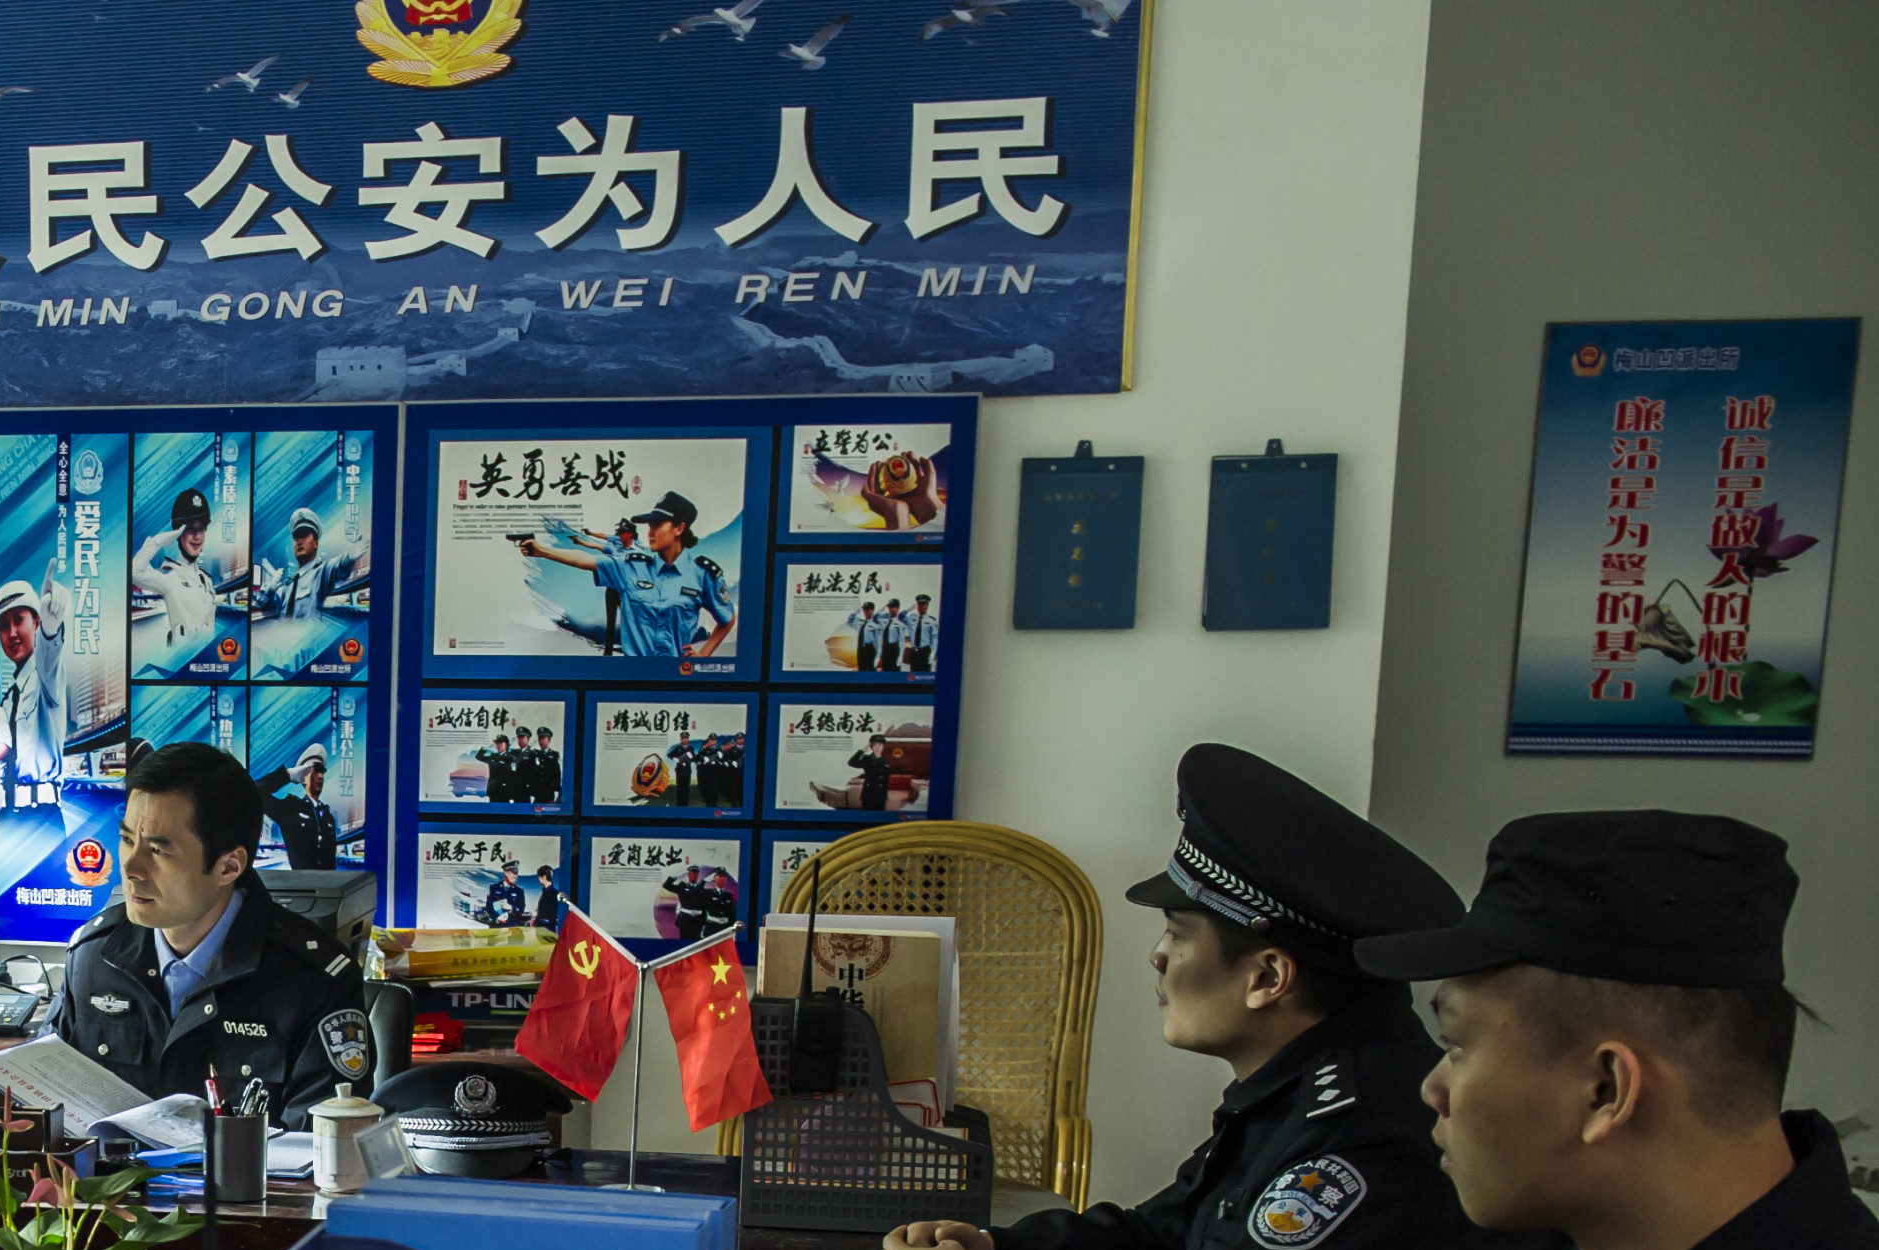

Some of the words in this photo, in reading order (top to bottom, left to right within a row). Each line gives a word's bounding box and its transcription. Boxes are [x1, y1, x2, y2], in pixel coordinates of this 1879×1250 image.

[36, 296, 132, 328] MIN
[201, 289, 345, 322] GONG
[398, 284, 480, 316] AN
[559, 276, 674, 309] WEI
[736, 270, 869, 304] REN
[919, 264, 1037, 299] MIN
[811, 429, 893, 455] 立警为公
[58, 441, 69, 497] 全心全意
[469, 447, 629, 501] 英勇善战
[1588, 395, 1665, 702] 廉洁是为警的基石
[1692, 395, 1776, 702] 诚信是做人的根本
[74, 500, 101, 655] 爱民为民
[434, 705, 510, 731] 诚信自律
[612, 709, 691, 733] 精诚团结
[431, 839, 507, 863] 服务于民
[607, 842, 683, 867] 爱岗敬业
[15, 887, 93, 907] 梅山凹派出所
[446, 992, 536, 1009] TP-LIN
[223, 1020, 268, 1037] 014526
